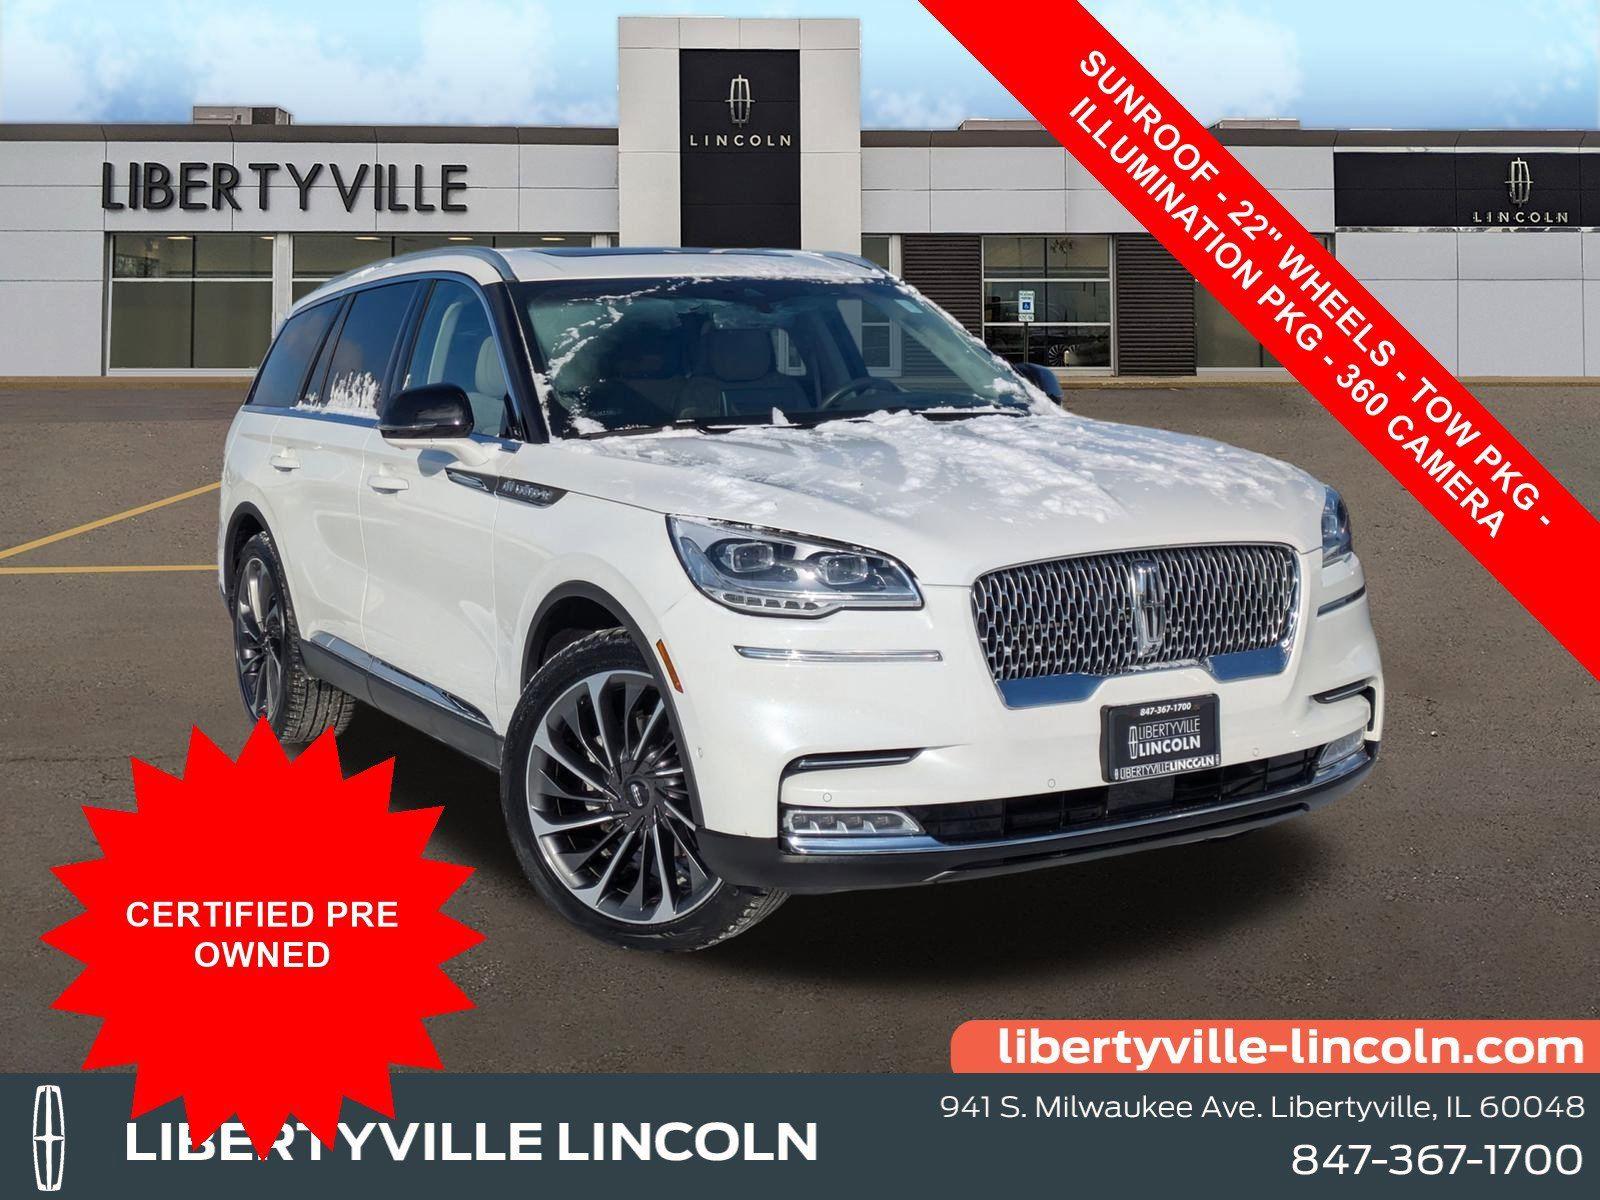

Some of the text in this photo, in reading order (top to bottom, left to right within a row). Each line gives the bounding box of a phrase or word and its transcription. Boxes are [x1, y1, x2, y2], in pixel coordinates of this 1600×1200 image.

[690, 134, 791, 147] LINCOLN
[101, 161, 469, 213] LIBERTYVILLE
[1474, 211, 1568, 223] LINCOLN
[1140, 702, 1192, 717] 847-367-1700
[1138, 718, 1201, 740] LIBERTYVILLE
[1138, 735, 1201, 757] LINCOLN
